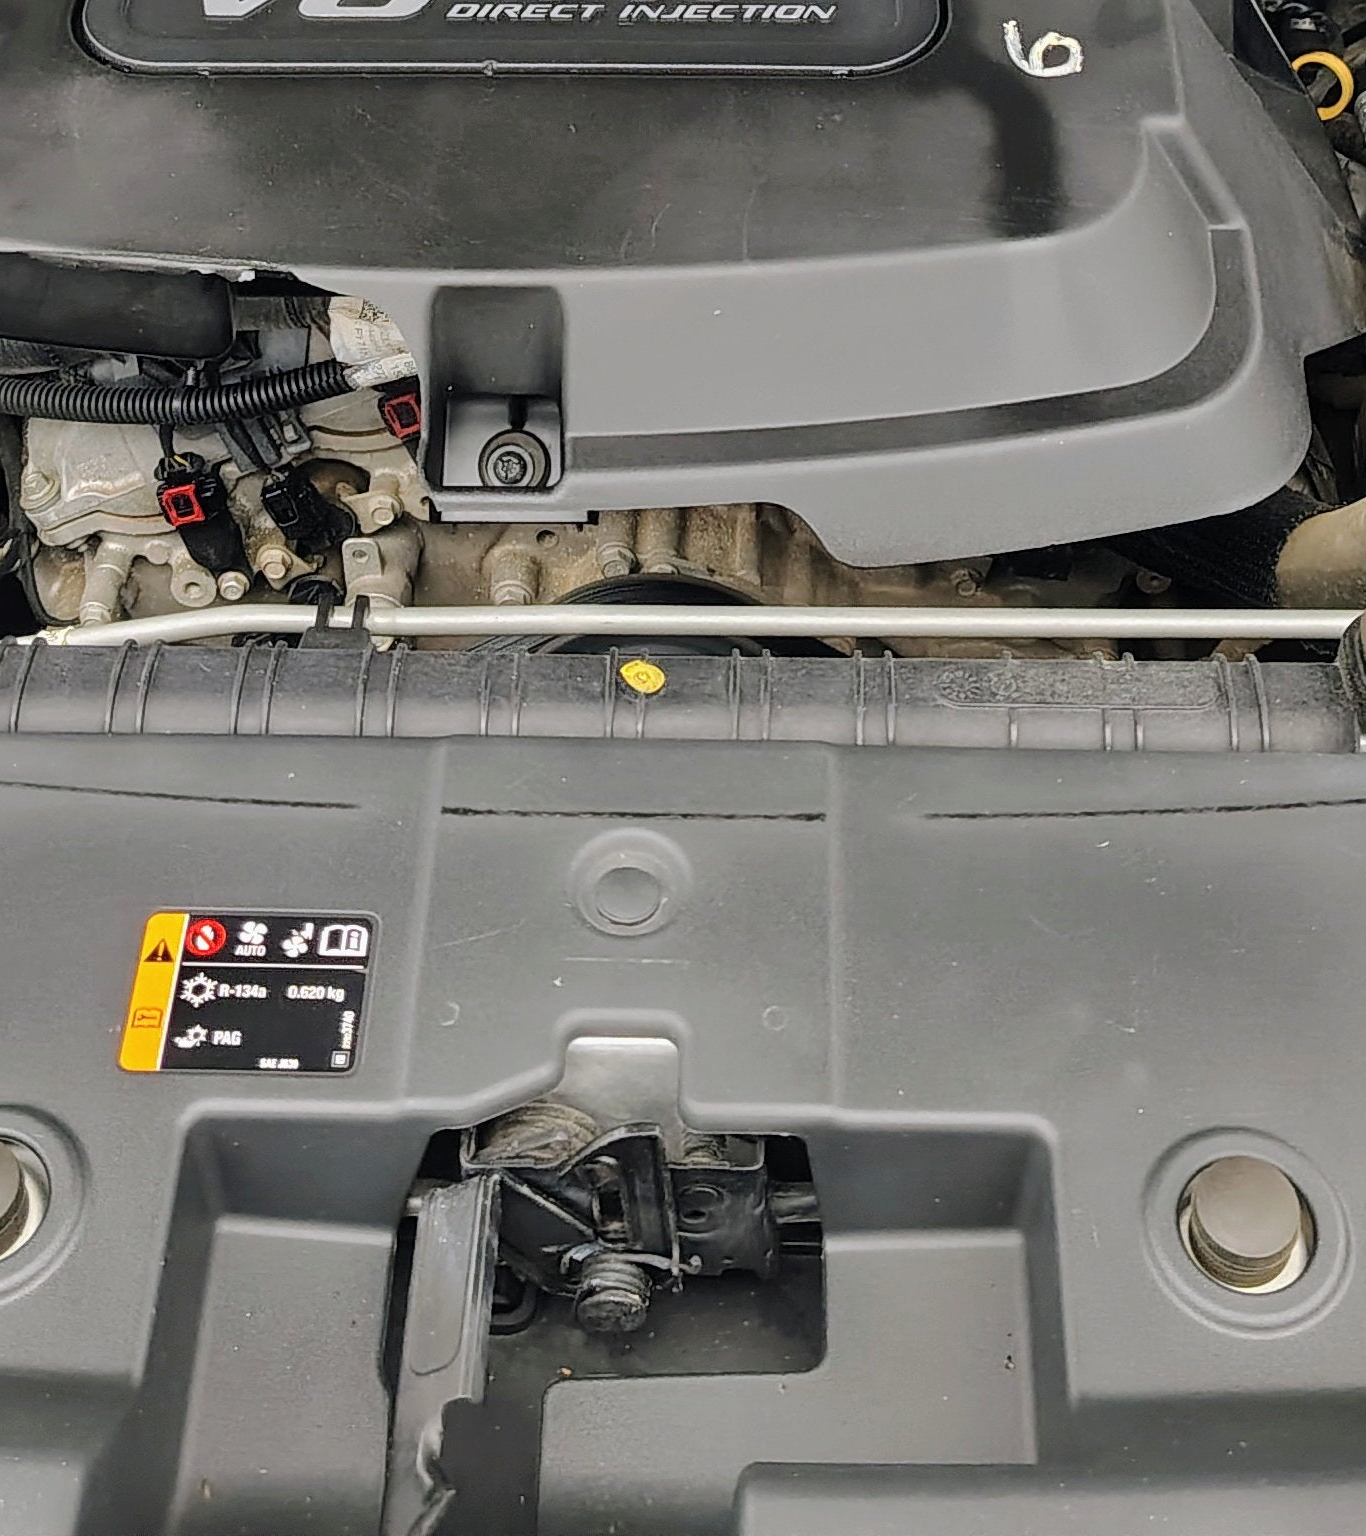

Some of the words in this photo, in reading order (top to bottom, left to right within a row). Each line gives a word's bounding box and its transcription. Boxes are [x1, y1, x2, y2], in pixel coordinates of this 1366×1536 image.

[443, 1, 606, 21] DIRECT
[617, 1, 837, 22] INJECTION
[1002, 20, 1085, 78] 6
[235, 944, 267, 957] AUTO
[218, 983, 267, 999] R-134a
[286, 984, 326, 1000] 0.620
[327, 985, 346, 1003] kg
[212, 1029, 242, 1046] PAG
